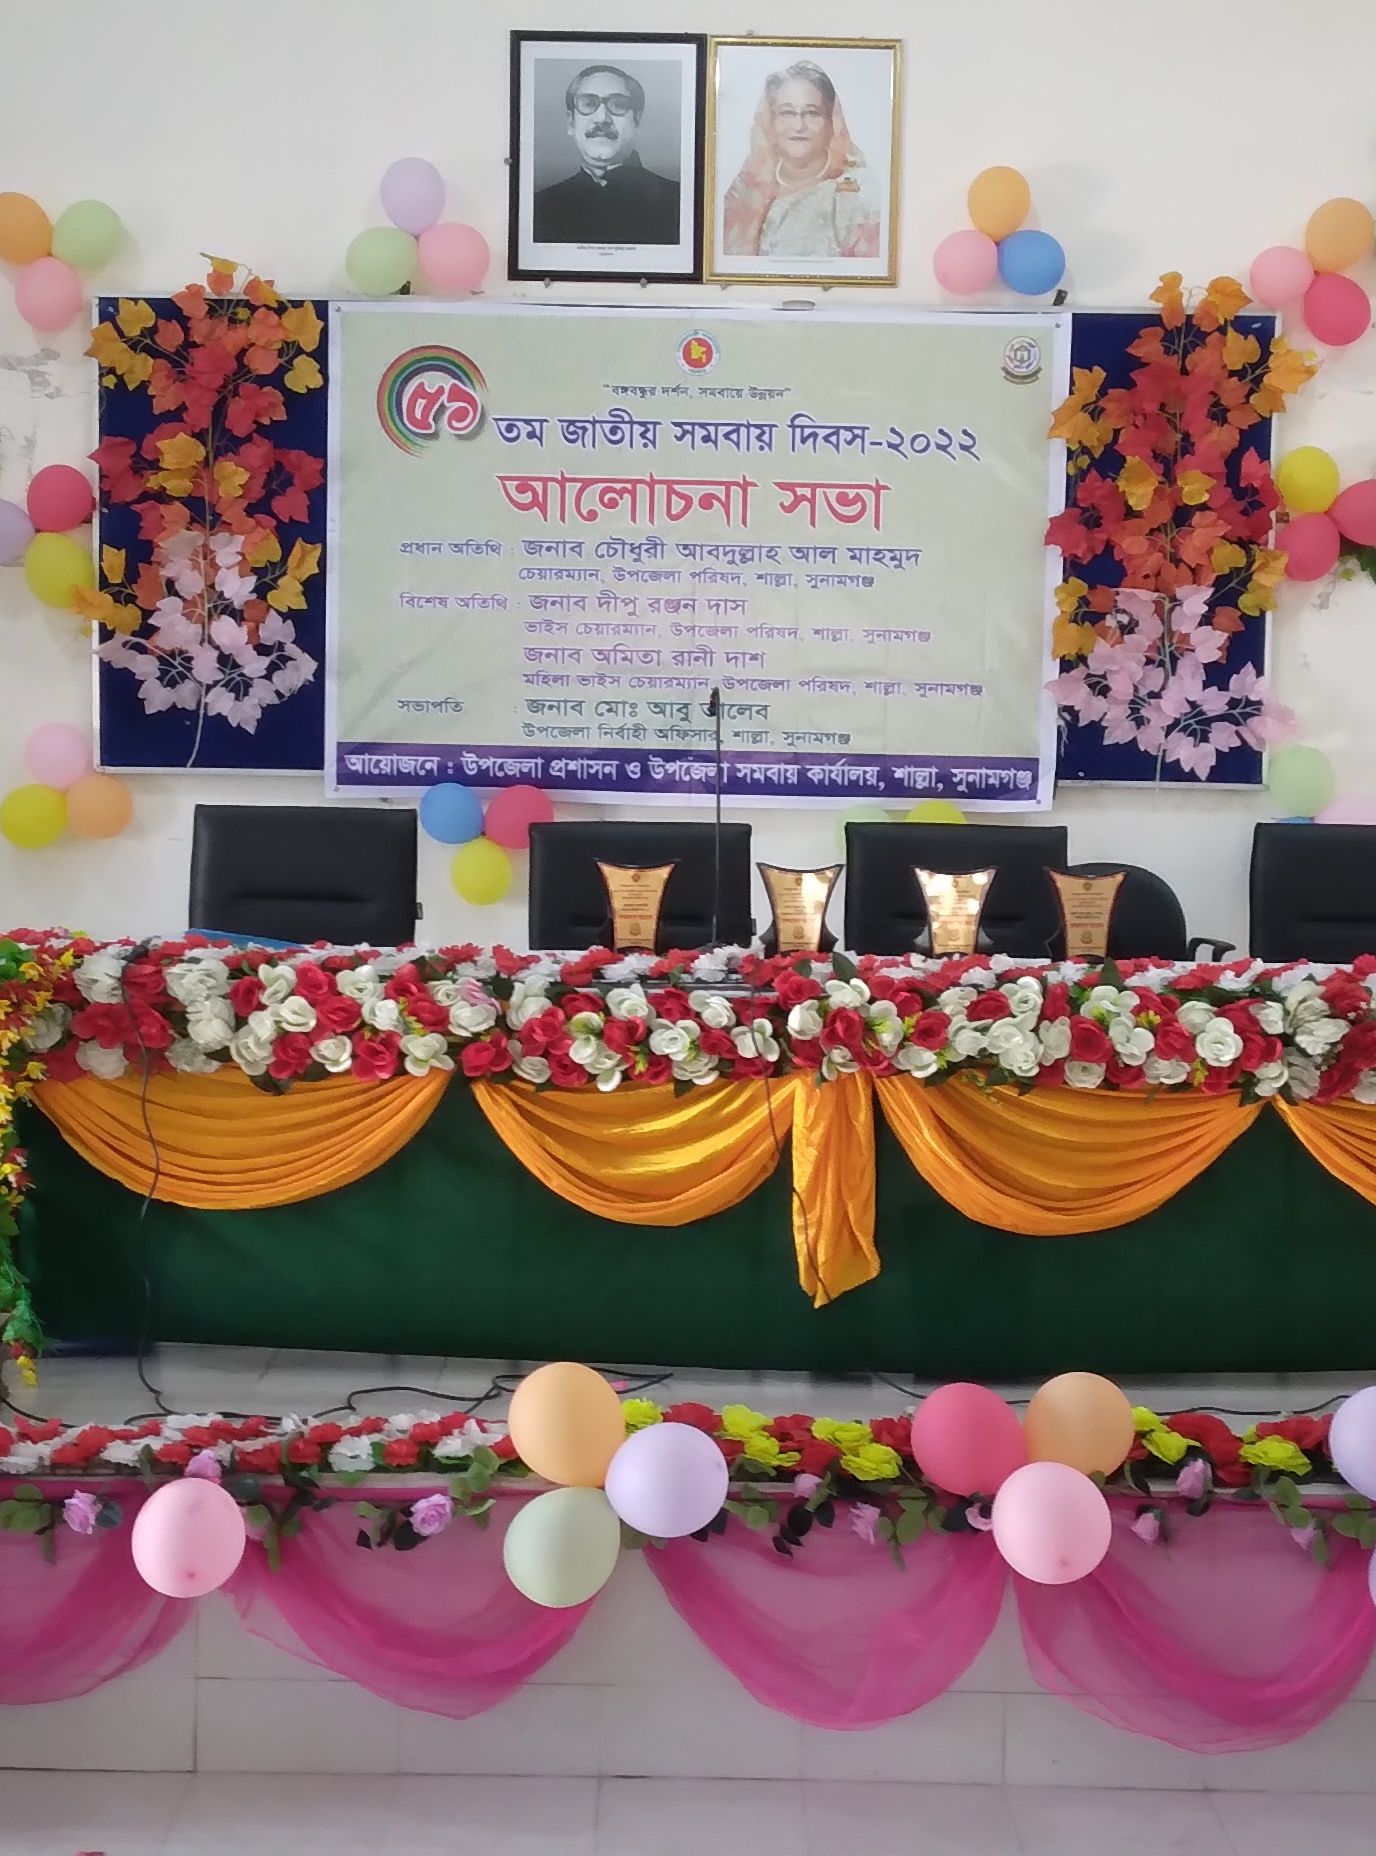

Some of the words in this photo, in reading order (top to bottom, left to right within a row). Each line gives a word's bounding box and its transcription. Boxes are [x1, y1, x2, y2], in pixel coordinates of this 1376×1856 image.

[493, 416, 549, 447] তম
[558, 408, 662, 450] জাতীয়
[671, 420, 777, 453] সমবায়
[788, 412, 981, 461] দিবস-২০২২
[496, 470, 759, 528] আলোচনা
[773, 477, 892, 532] সভা
[399, 541, 442, 557] প্রধান
[450, 538, 502, 557] অতিথি
[521, 539, 585, 558] জনাব
[595, 535, 666, 563] চৌধুরী
[676, 543, 781, 565] আবদুল্লাহ
[790, 546, 837, 564] আল
[847, 547, 922, 569] মাহমুদ
[612, 566, 680, 583] উপজেলা
[689, 567, 747, 587] পরিষদ,
[806, 574, 875, 590] সুনামগঞ্জ
[400, 593, 448, 609] বিশেষ
[455, 593, 508, 611] অতিথি
[529, 594, 588, 612] জনাব
[596, 590, 639, 617] দীপু
[648, 598, 696, 614] রঞ্জন
[708, 599, 748, 616] দাস
[524, 619, 568, 636] ভাইস
[670, 622, 737, 638] উপজেলা
[862, 629, 933, 644] সুনামগঞ্জ
[523, 646, 582, 665] জনাব
[592, 643, 662, 666] অমিতা
[672, 645, 715, 668] রানী
[724, 651, 766, 669] দাশ
[522, 671, 571, 687] মহিলা
[577, 671, 621, 688] ভাইস
[722, 675, 790, 692] উপজেলা
[915, 682, 986, 699] সুনামগঞ্জ
[397, 696, 464, 713] সভাপতি
[525, 698, 585, 717] জনাব
[595, 699, 638, 716] মোঃ
[647, 701, 693, 725] আবু
[522, 722, 590, 740] উপজেলা
[598, 723, 647, 741] নির্বাহী
[782, 730, 851, 748] সুনামগঞ্জ
[344, 753, 441, 777] আয়োজনে
[461, 752, 544, 779] উপজেলা
[549, 757, 619, 780] প্রশাসন
[625, 763, 641, 779] ও
[649, 756, 728, 784] উপজেলা
[736, 762, 800, 786] সমবায়
[807, 758, 884, 790] কার্যালয়,
[893, 766, 944, 790] শাল্লা,
[951, 768, 1033, 793] সুনামগঞ্জ
